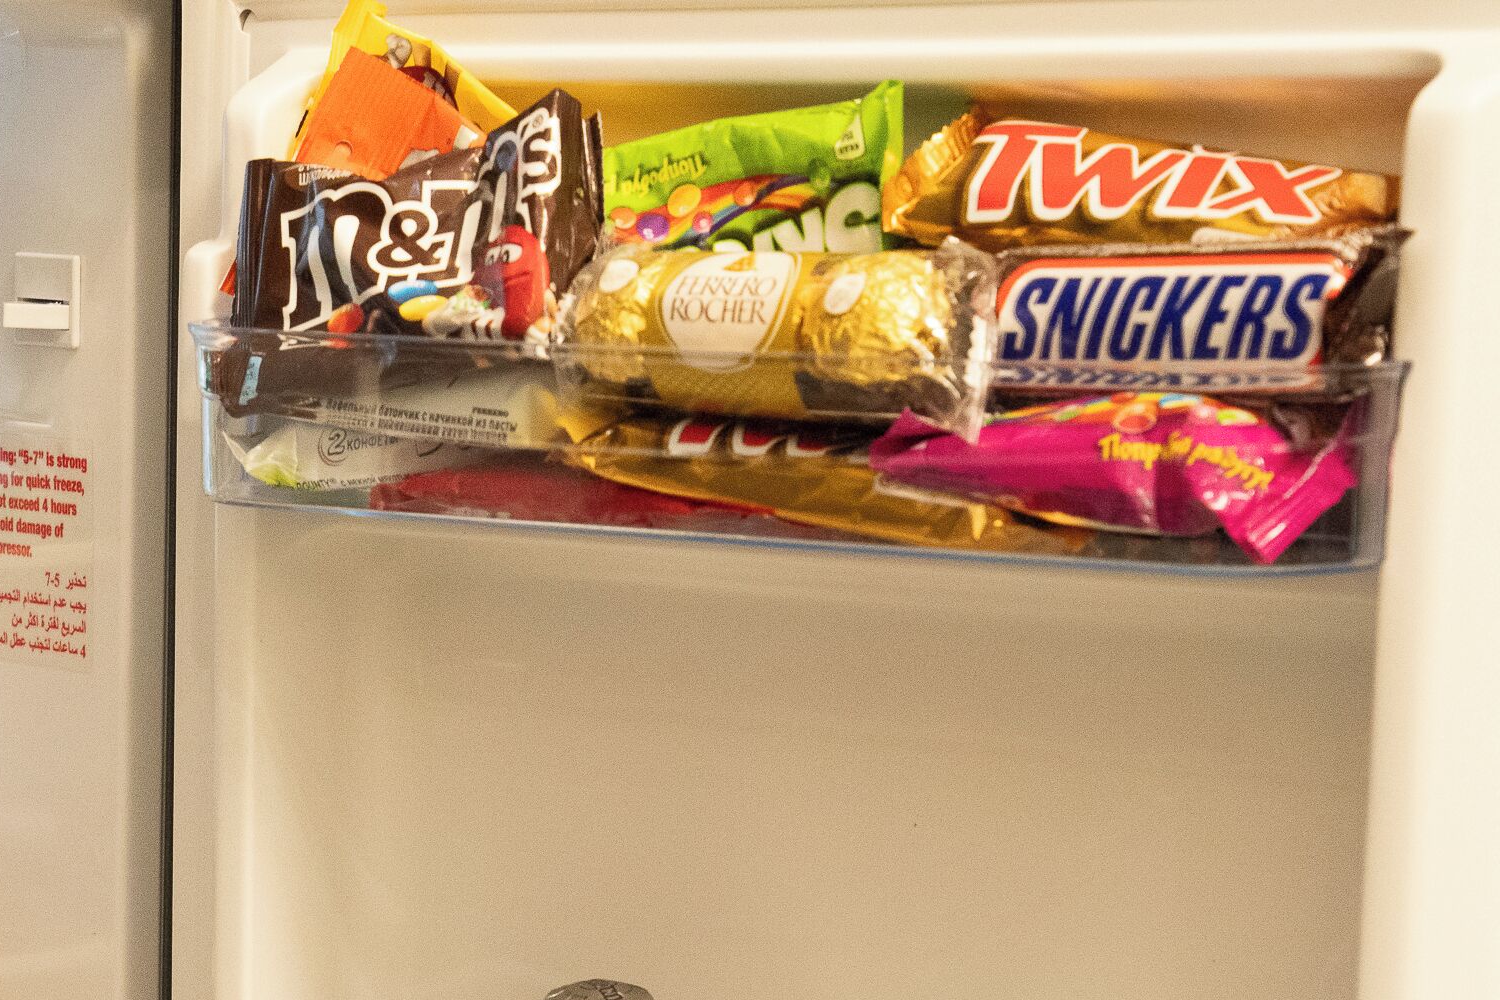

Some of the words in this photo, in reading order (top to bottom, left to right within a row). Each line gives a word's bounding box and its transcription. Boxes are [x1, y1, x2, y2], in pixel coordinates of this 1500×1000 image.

[966, 120, 1342, 225] TWIX
[674, 272, 779, 298] FERRERO
[669, 296, 769, 326] ROCHER
[1001, 273, 1330, 363] SNICKERS
[327, 429, 347, 456] 2
[46, 452, 55, 468] is
[57, 455, 87, 473] strong
[11, 471, 23, 486] for
[26, 473, 51, 492] quick
[54, 475, 85, 496] freeze,
[8, 495, 40, 512] exceed
[42, 498, 48, 513] 4
[51, 499, 77, 516] hours
[16, 519, 52, 539] damage
[54, 523, 64, 538] of
[66, 572, 87, 590] تحذير
[53, 597, 67, 609] عدم
[70, 599, 87, 614] يجب
[11, 613, 23, 628] من
[61, 620, 87, 637] السريع
[52, 640, 78, 656] ساعات
